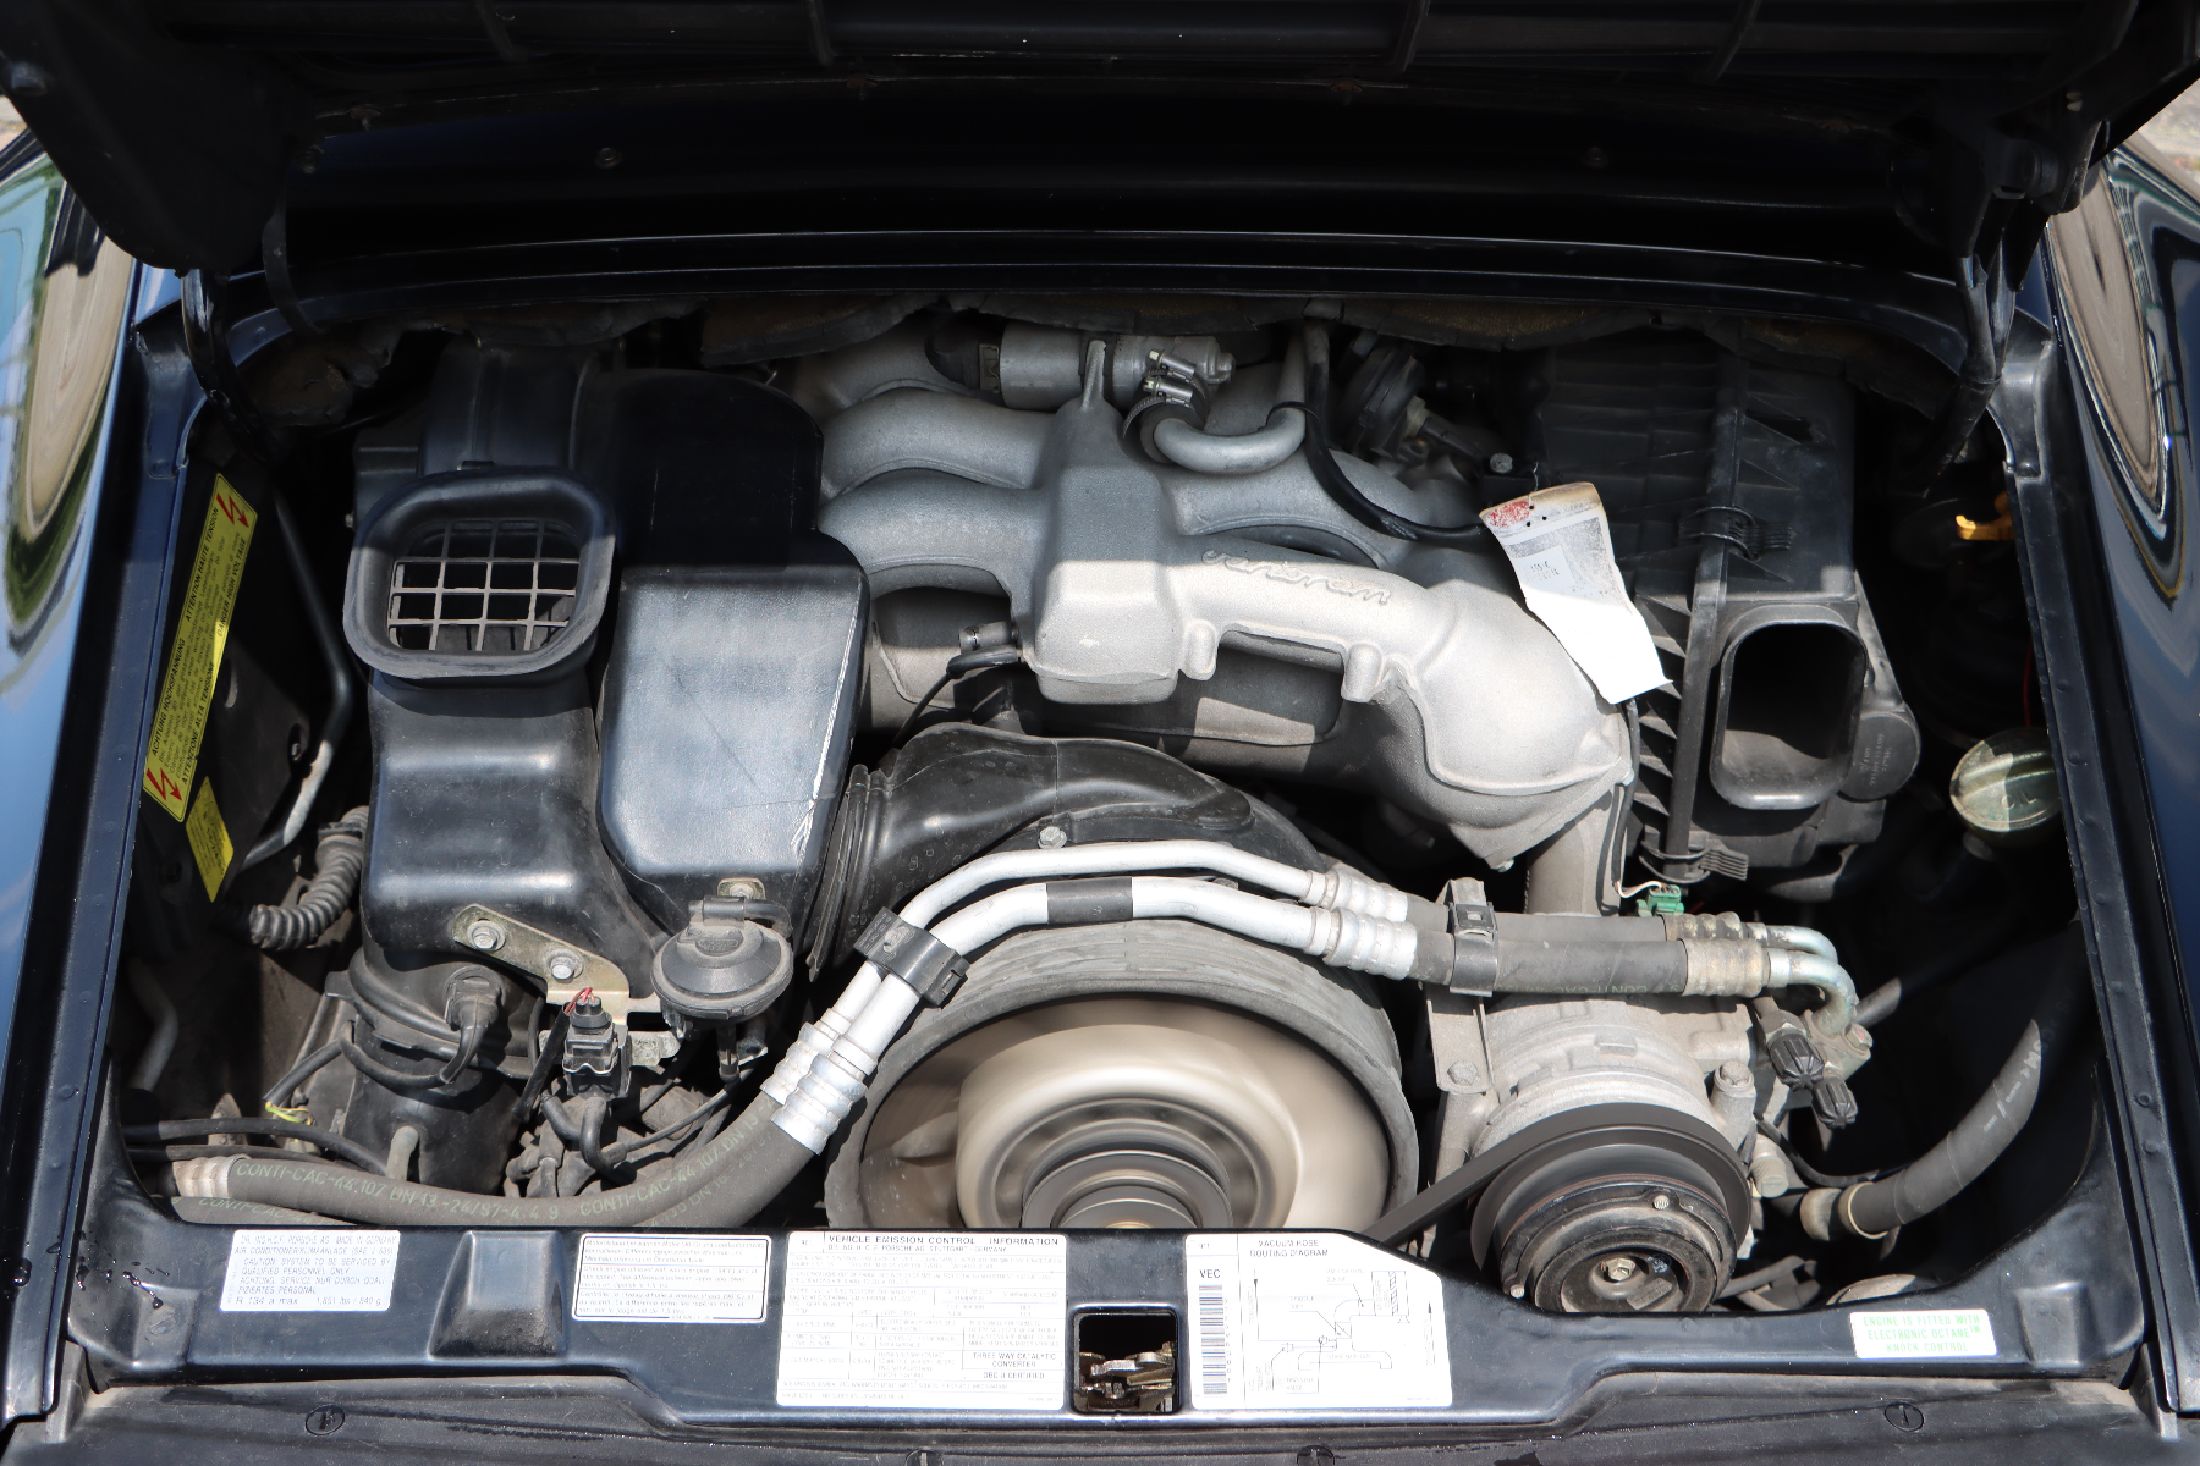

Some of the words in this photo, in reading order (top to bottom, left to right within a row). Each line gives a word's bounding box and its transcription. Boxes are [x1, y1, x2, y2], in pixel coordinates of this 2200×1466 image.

[829, 1235, 871, 1244] VEHICLE
[875, 1235, 924, 1245] EMISSION
[928, 1236, 976, 1245] CONTROL
[989, 1237, 1058, 1246] INFORMATION
[1289, 1249, 1328, 1257] DIAGRAM
[1199, 1268, 1221, 1279] VEC
[1863, 1316, 1899, 1327] ENGINE
[1903, 1316, 1913, 1326] IS
[1917, 1315, 1952, 1325] FITTED
[1955, 1314, 1980, 1325] WITH
[1868, 1329, 1928, 1340] ELECTRONIC
[972, 1352, 996, 1360] THREE
[998, 1352, 1017, 1360] WAY
